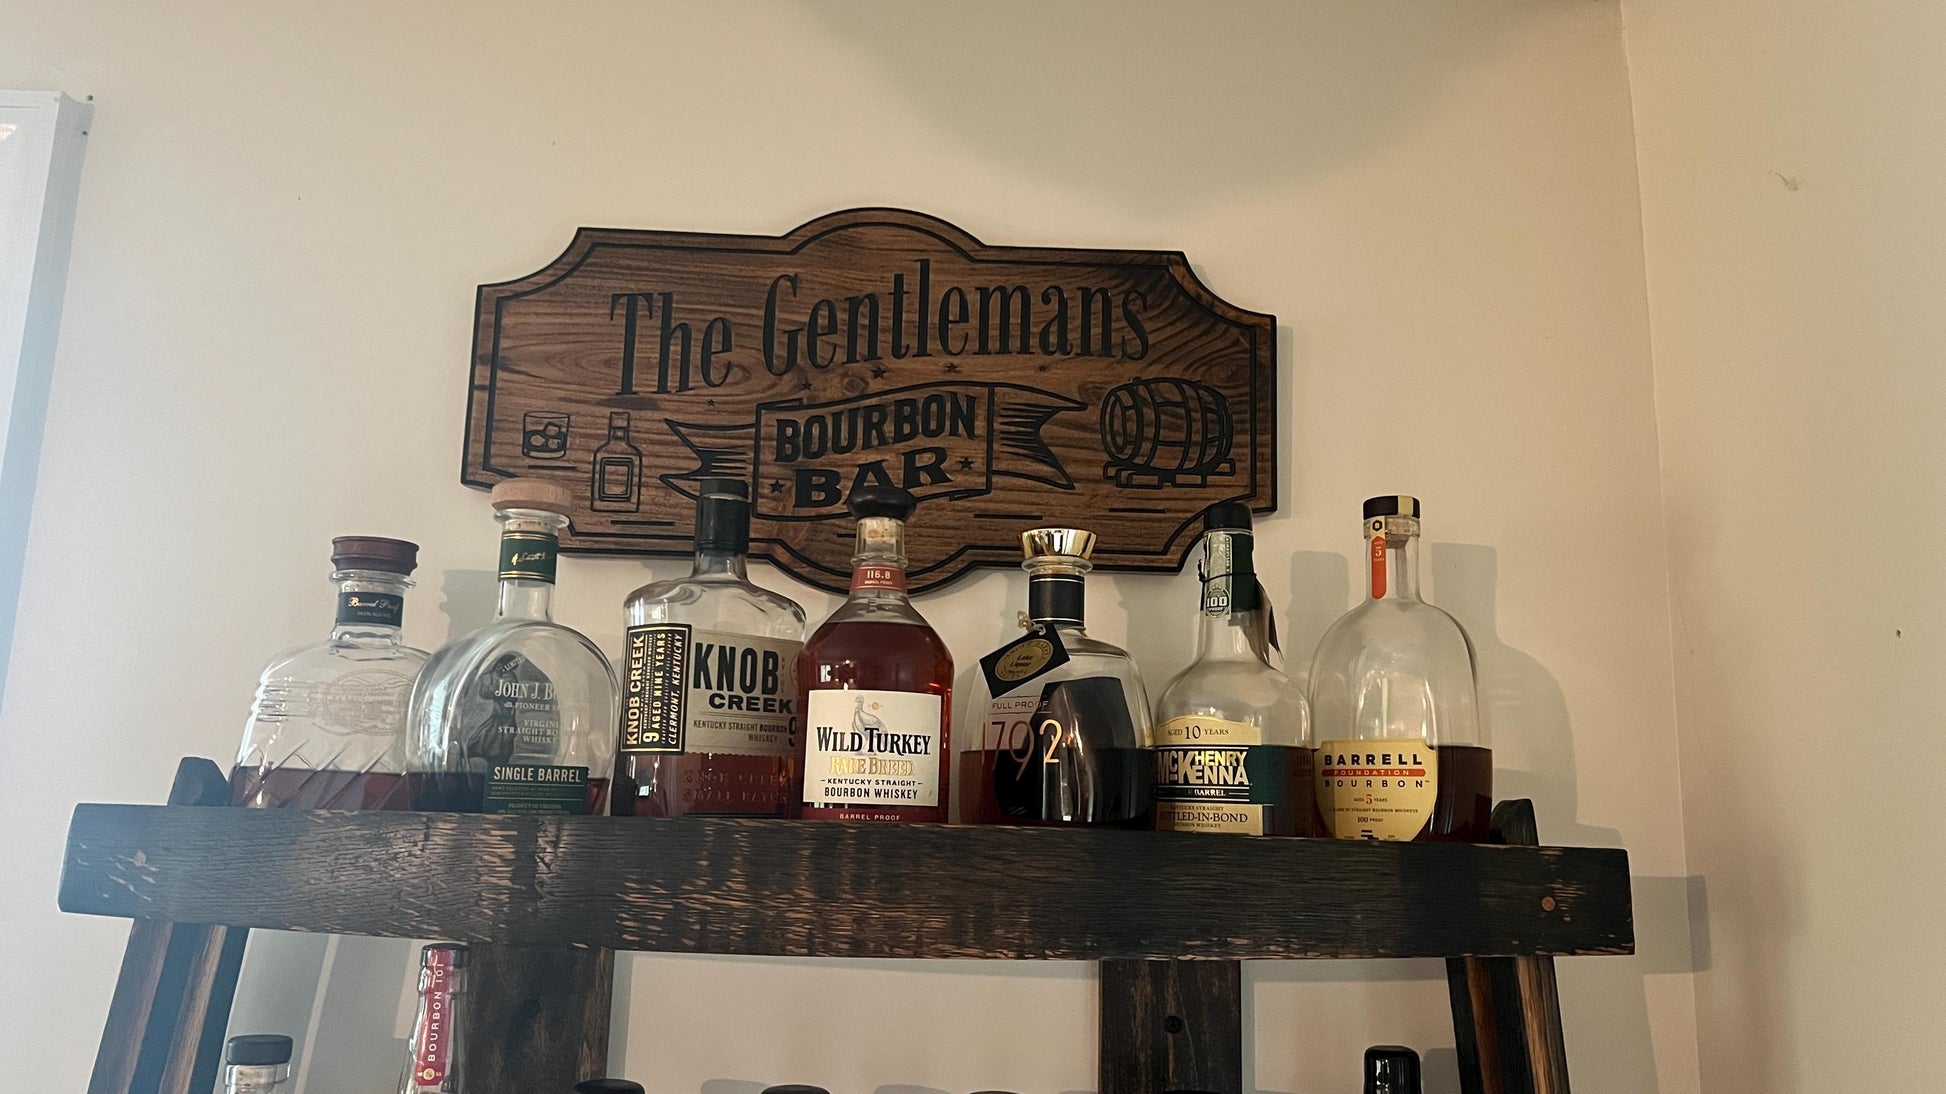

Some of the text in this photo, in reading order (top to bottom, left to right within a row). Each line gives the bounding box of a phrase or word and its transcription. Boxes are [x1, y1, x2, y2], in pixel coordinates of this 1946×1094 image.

[610, 257, 1150, 396] The Gentlemans
[774, 391, 976, 463] BOURBON
[793, 446, 954, 508] BAR
[1375, 546, 1382, 557] 5
[867, 570, 890, 579] 116.8
[1207, 597, 1228, 607] 100
[693, 643, 779, 695] KNOB
[495, 679, 529, 698] JOHN
[531, 682, 541, 699] J.
[651, 633, 666, 729] AGED NINE YEARS
[668, 633, 682, 745] CLERMONT, KENTUCKY
[626, 635, 644, 745] KNOB CREEK
[709, 693, 792, 714] CREEK
[992, 700, 1049, 710] FULL PROOF
[498, 726, 544, 735] STRAIGHT
[693, 720, 727, 730] KENTUCKY
[728, 722, 758, 732] STRAIGHT
[1185, 725, 1201, 739] 10
[642, 732, 660, 743] 9
[748, 733, 778, 742] WHISKEY
[816, 726, 931, 756] WILD TURKEY
[982, 719, 1063, 781] 1792
[1194, 750, 1247, 766] HENRY
[829, 756, 914, 776] RARE BREED
[1324, 754, 1422, 765] BARRELL
[493, 766, 581, 782] SINGLE BARREL
[1324, 780, 1423, 788] BOURBON
[824, 787, 918, 799] BOURBON WHISKEY
[1194, 789, 1226, 797] BARREL
[1366, 794, 1372, 805] 5
[427, 991, 442, 1061] BOURBON
[435, 963, 445, 983] 101
